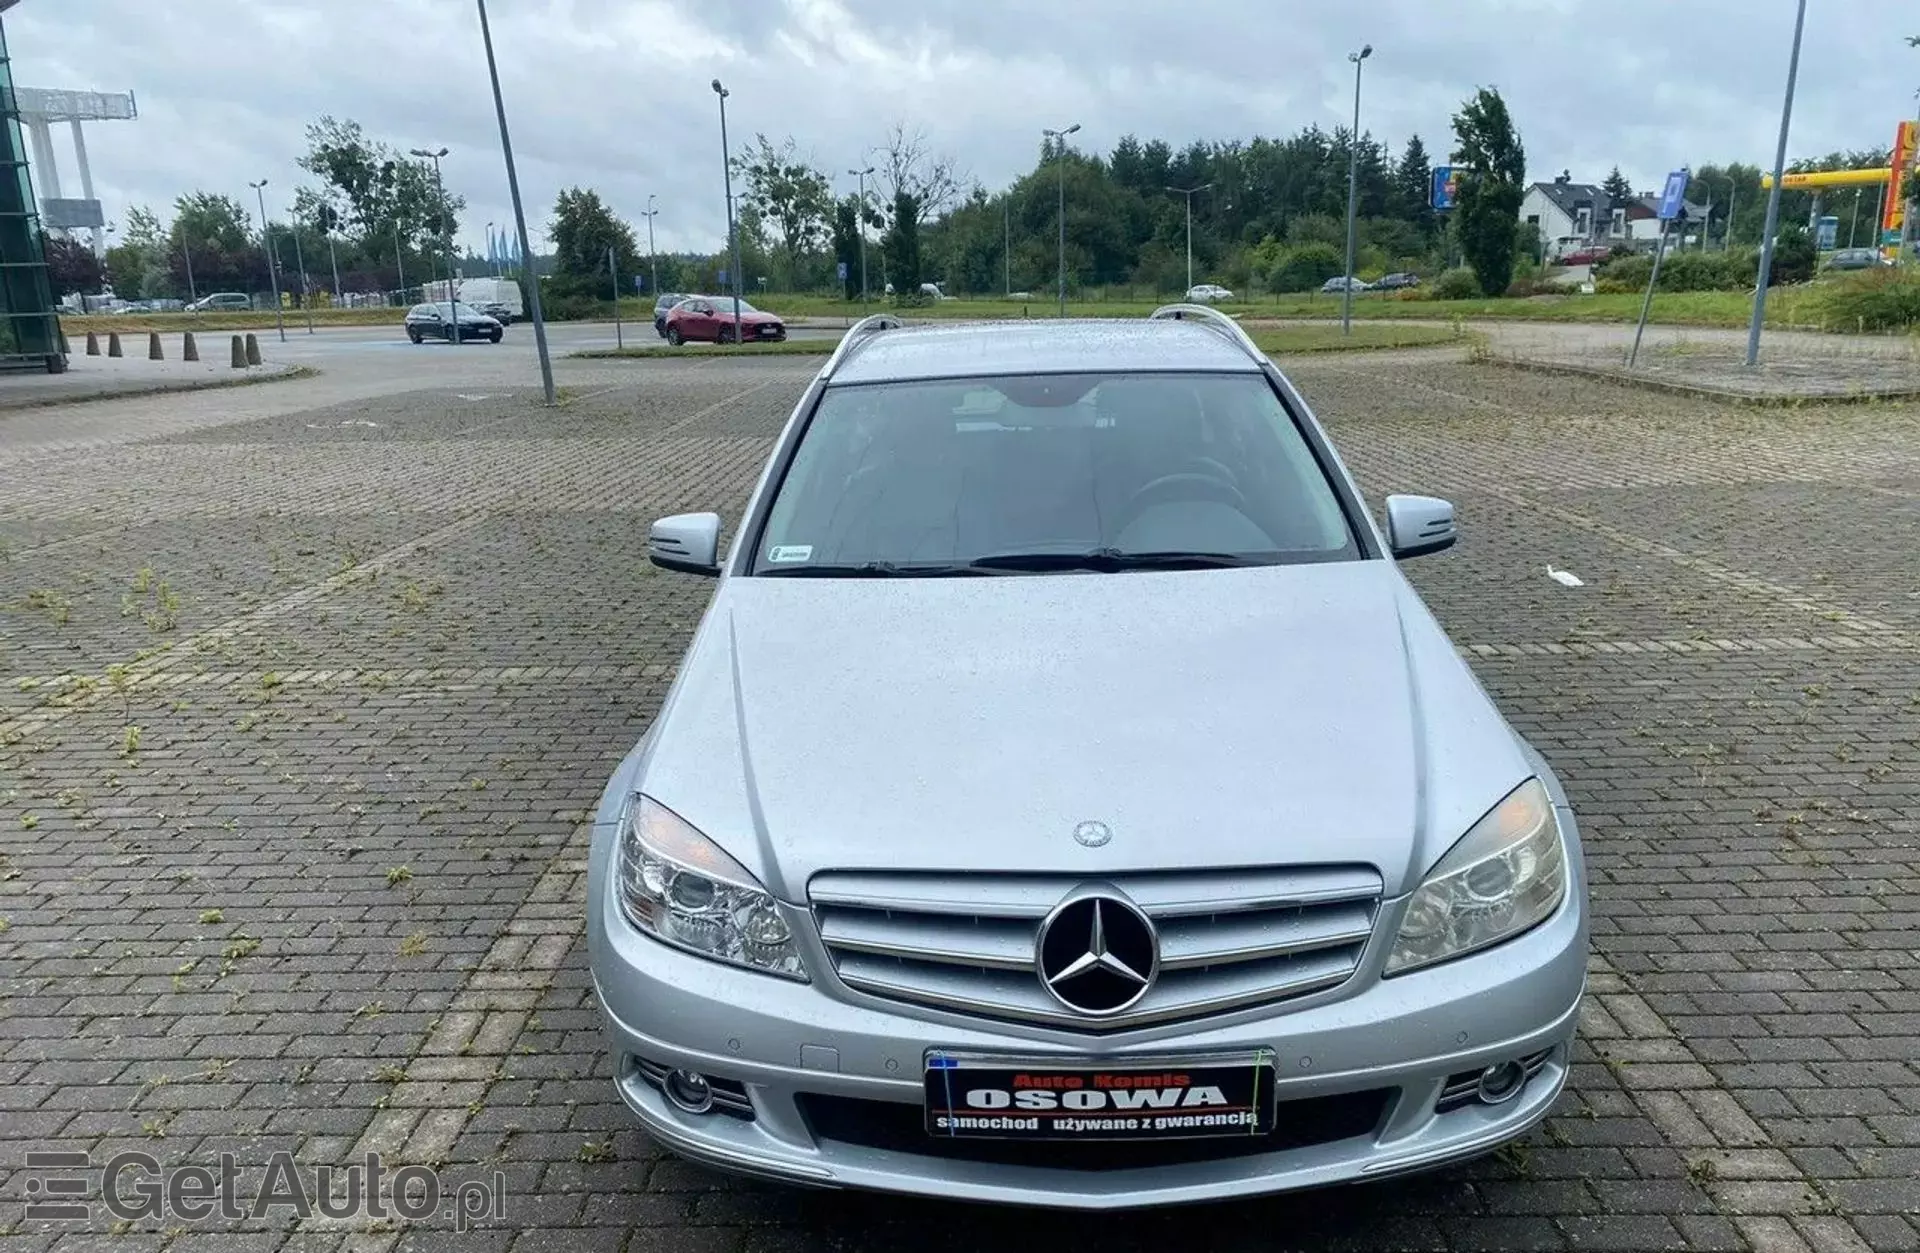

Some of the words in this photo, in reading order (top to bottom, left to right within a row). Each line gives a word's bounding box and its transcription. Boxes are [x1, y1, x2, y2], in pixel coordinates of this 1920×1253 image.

[1013, 1074, 1083, 1088] Auto
[1093, 1074, 1190, 1088] Komis
[966, 1086, 1228, 1110] OSOWA
[1053, 1117, 1138, 1132] używane
[1141, 1119, 1151, 1129] z
